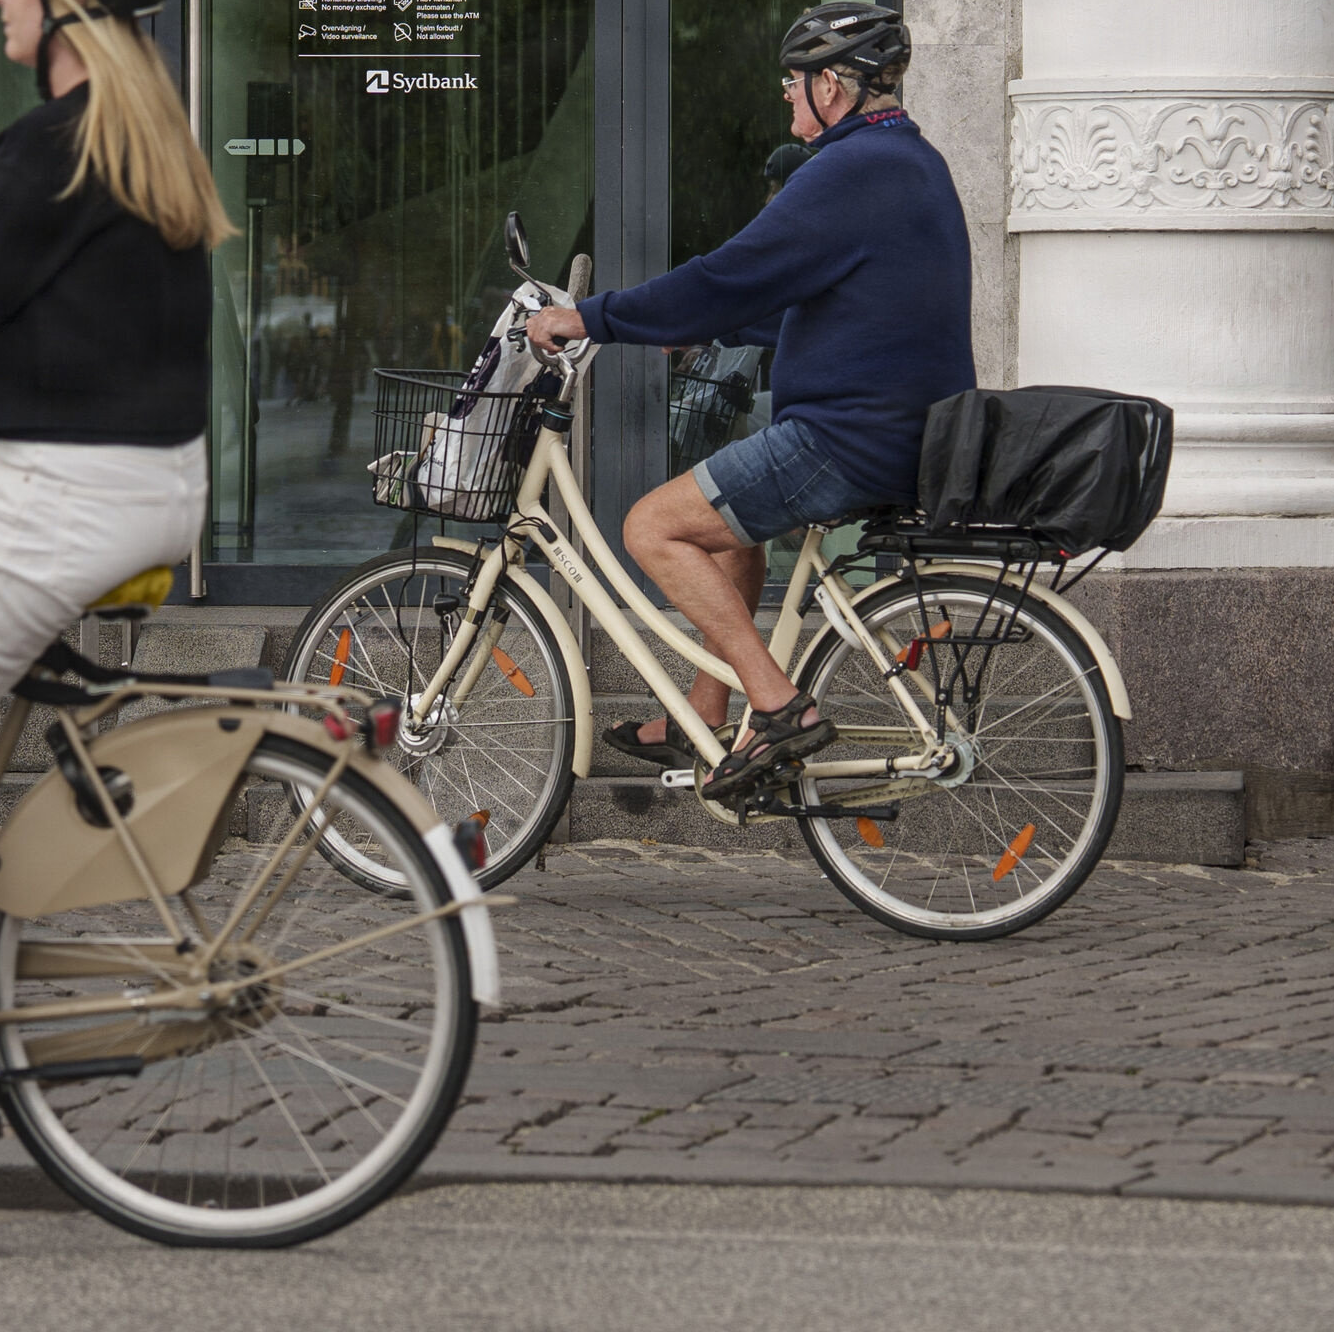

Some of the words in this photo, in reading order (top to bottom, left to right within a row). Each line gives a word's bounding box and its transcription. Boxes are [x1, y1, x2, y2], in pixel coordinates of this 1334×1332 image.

[355, 4, 387, 12] exchange
[416, 24, 435, 33] Hjelm
[393, 73, 478, 94] Sydbank
